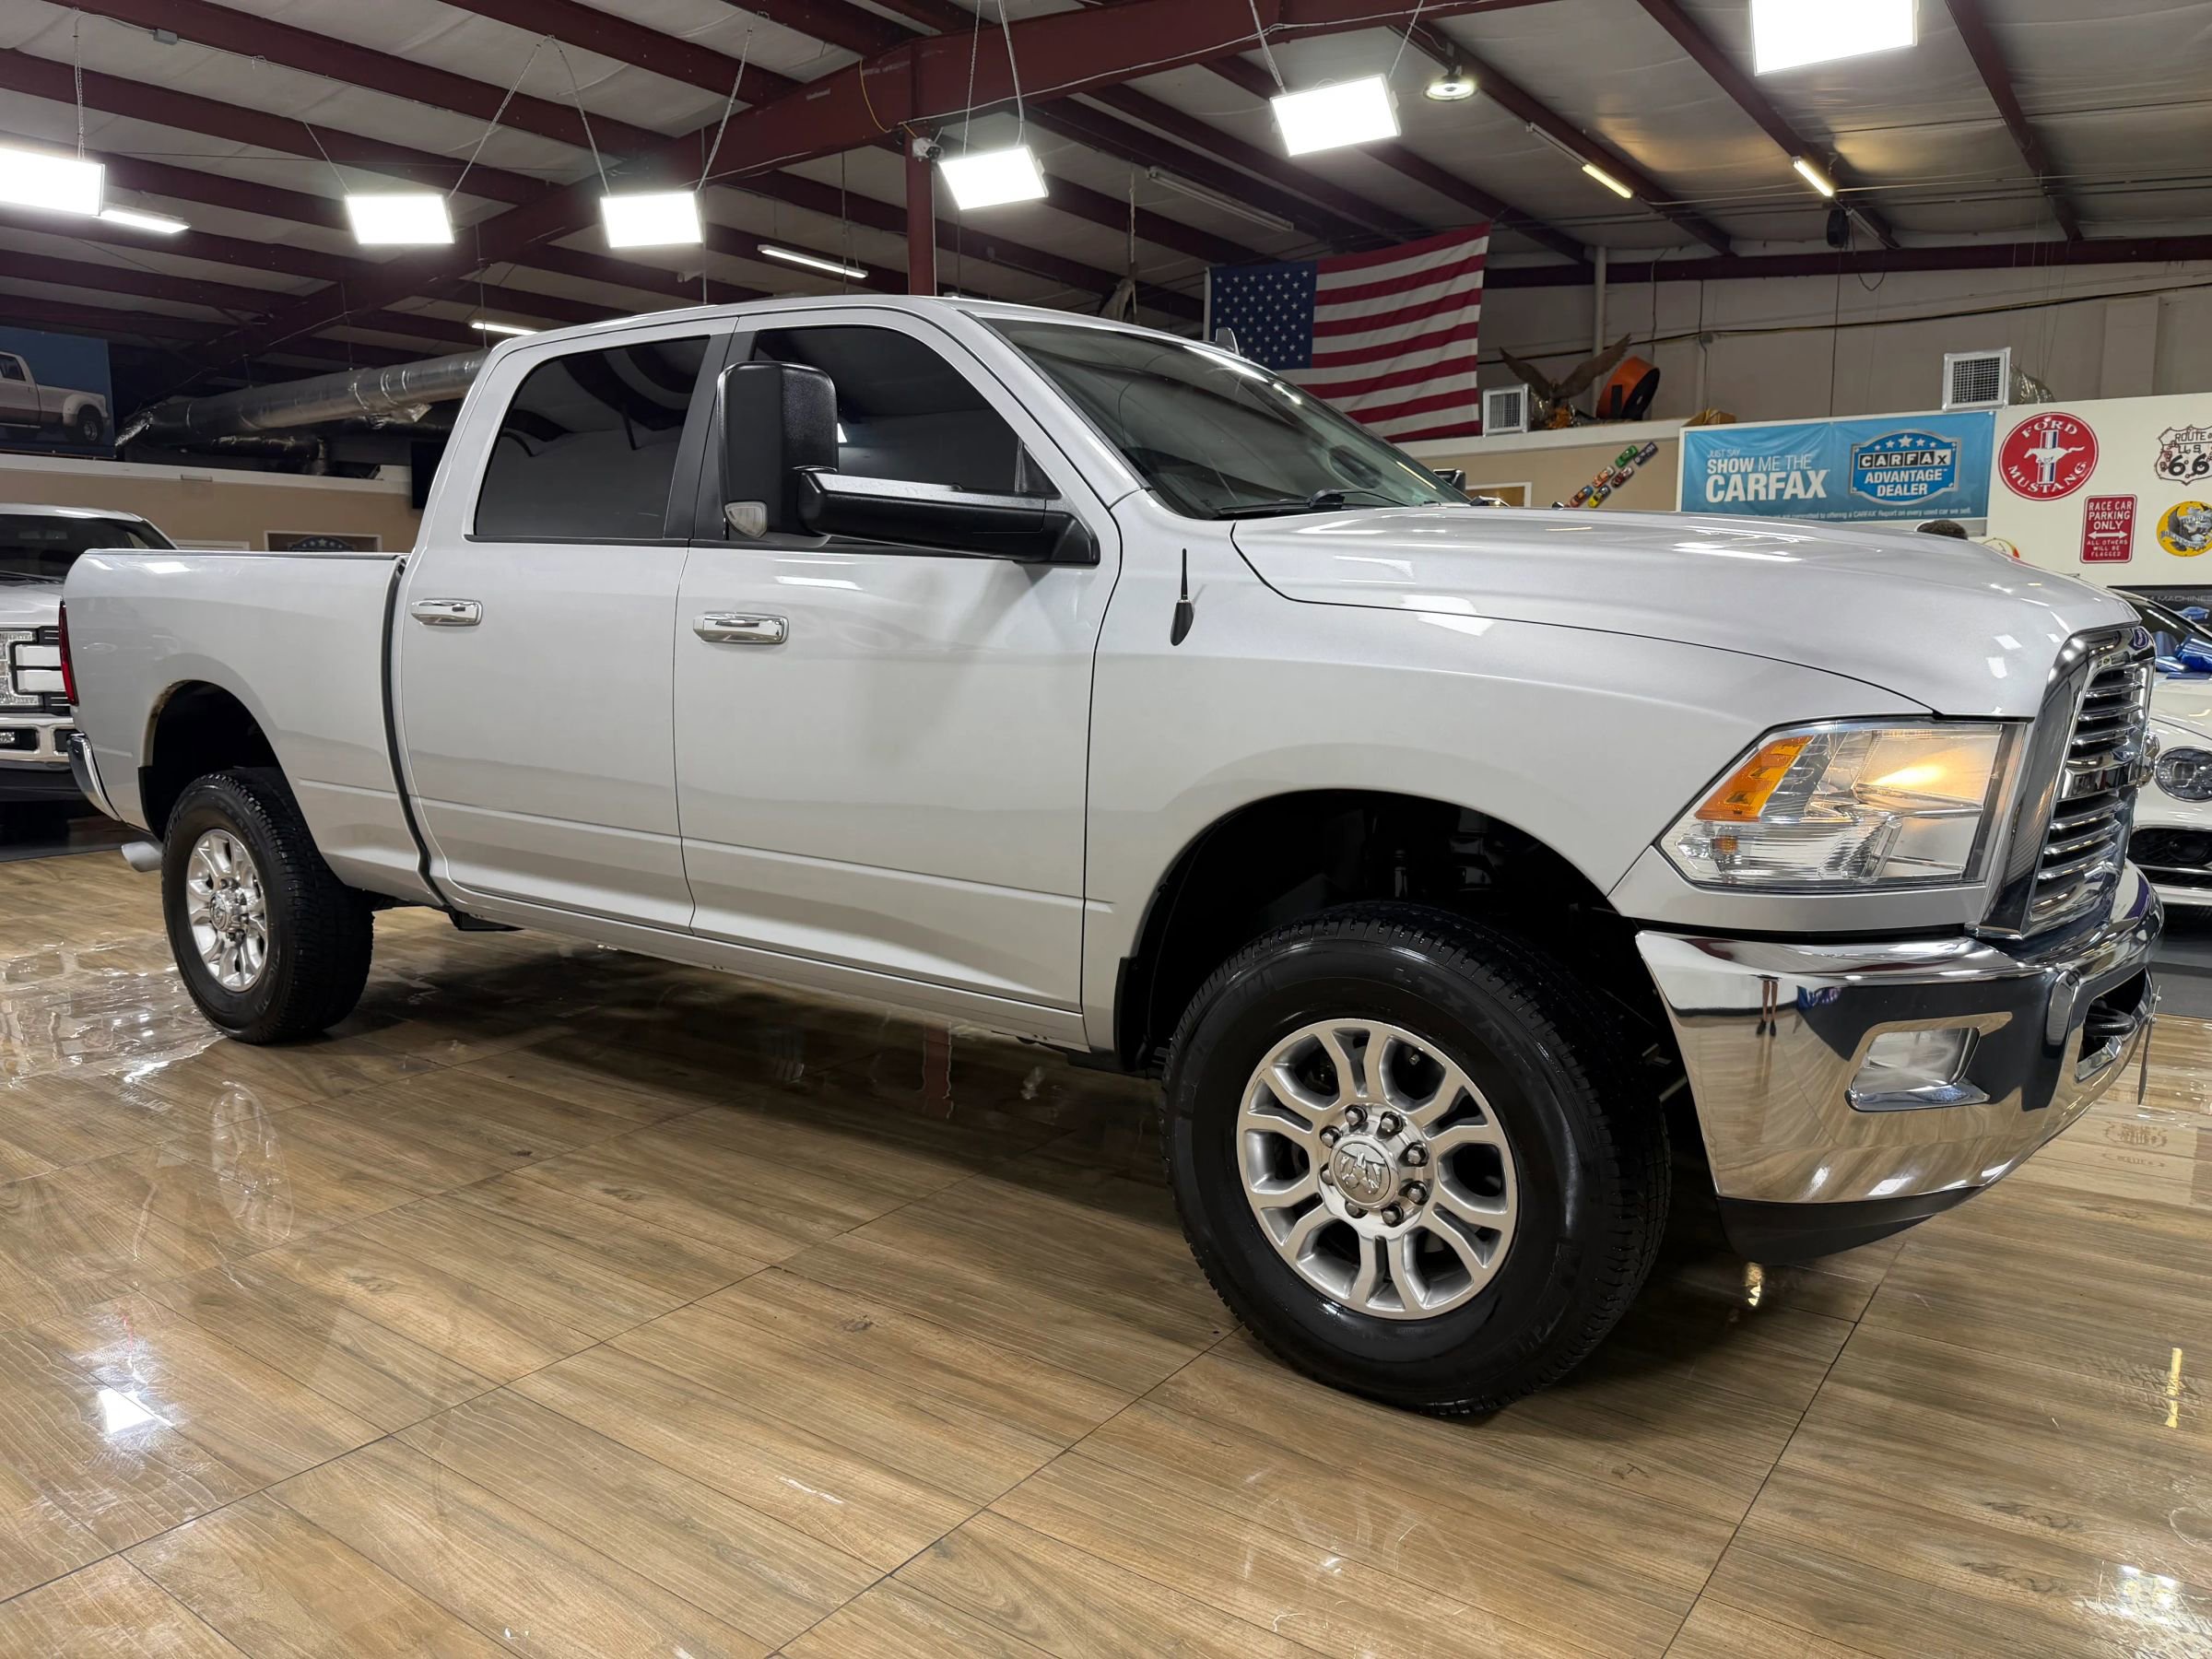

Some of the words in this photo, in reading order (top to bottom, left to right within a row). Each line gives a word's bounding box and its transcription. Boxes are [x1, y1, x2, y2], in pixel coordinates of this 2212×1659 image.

[2021, 419, 2078, 439] FORD
[2175, 430, 2206, 442] ROUTE
[1707, 450, 1725, 459] JUST
[1727, 448, 1741, 457] SAY
[1861, 453, 1948, 468] CARFAX
[1707, 457, 1755, 475] SHOW
[1758, 455, 1782, 472] ME
[1786, 454, 1813, 470] THE
[1865, 468, 1944, 484] ADVANTAGE
[2007, 461, 2088, 493] MUSTANG
[1705, 469, 1829, 503] CARFAX
[1877, 483, 1928, 498] DEALER
[2088, 501, 2112, 511] RACE
[2114, 500, 2132, 511] CAR
[1827, 512, 1846, 520] offering
[1878, 509, 1897, 518] Report
[2088, 511, 2131, 521] PARKING
[2093, 520, 2124, 530] ONLY
